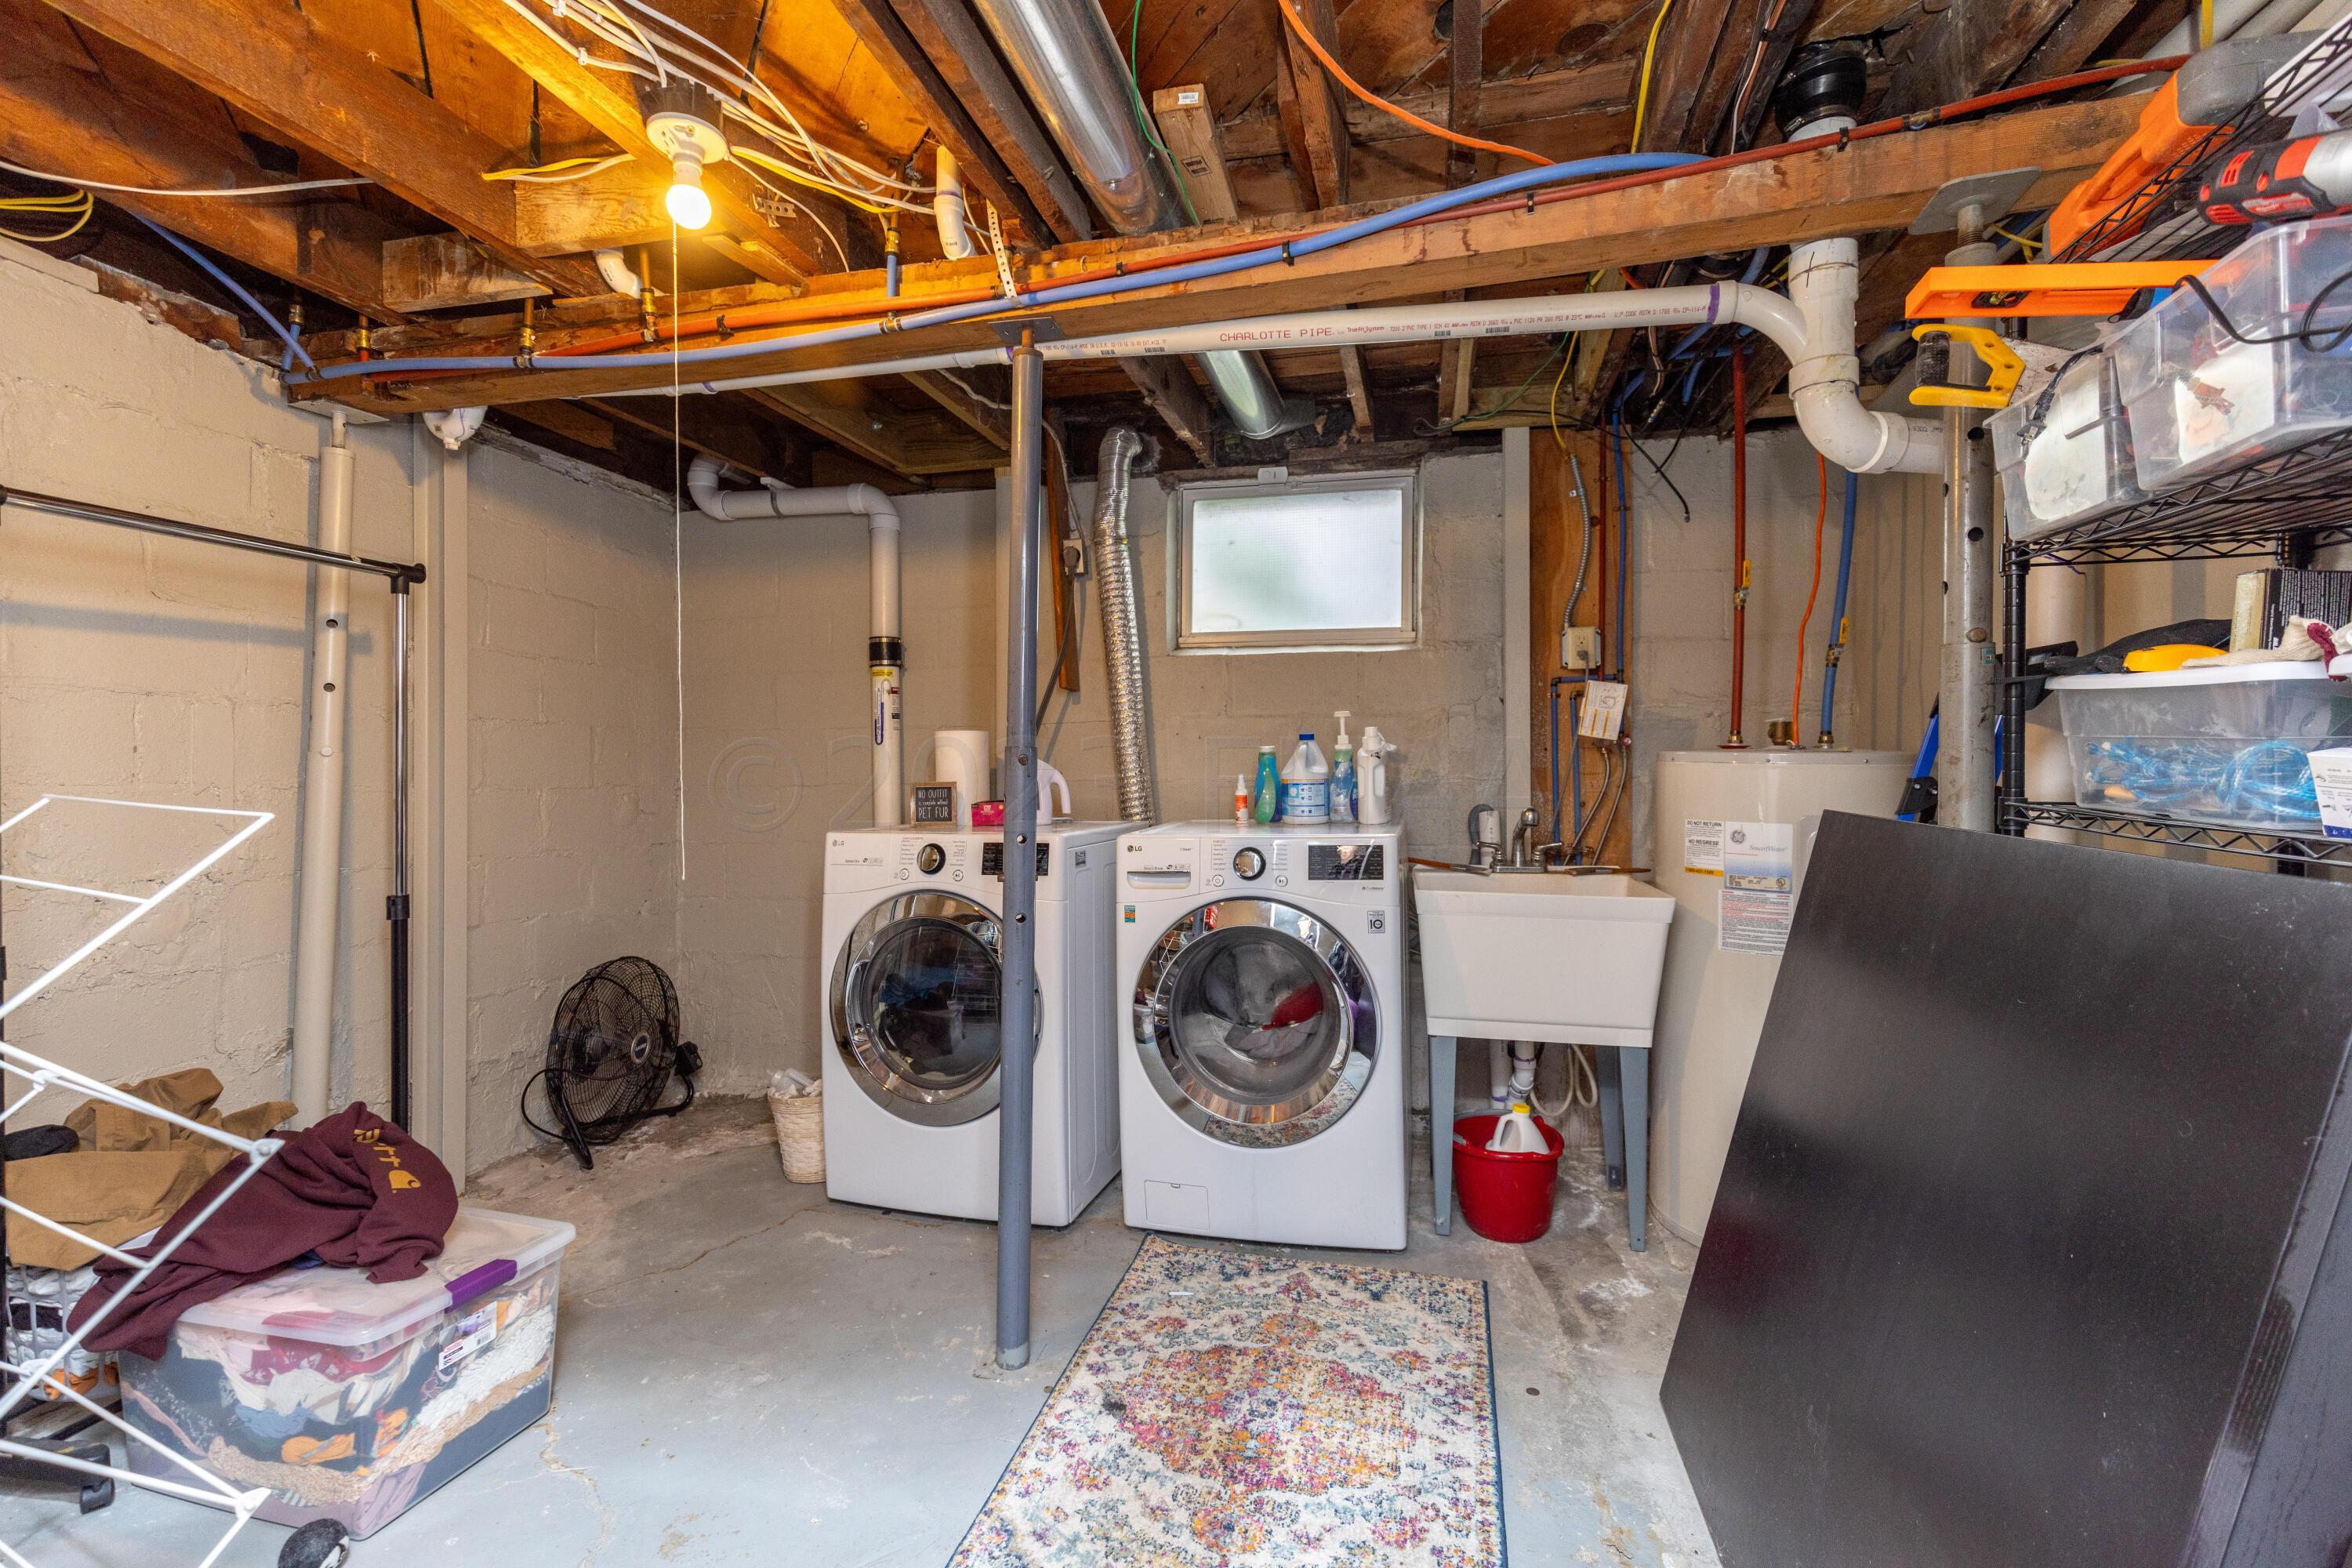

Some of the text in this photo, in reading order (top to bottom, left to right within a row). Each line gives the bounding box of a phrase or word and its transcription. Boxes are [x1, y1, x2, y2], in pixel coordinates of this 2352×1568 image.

[1220, 329, 1292, 342] CHARLOTTE
[918, 789, 948, 798] NO OUTFIT
[918, 806, 949, 819] PET FUR
[1370, 919, 1383, 930] 10
